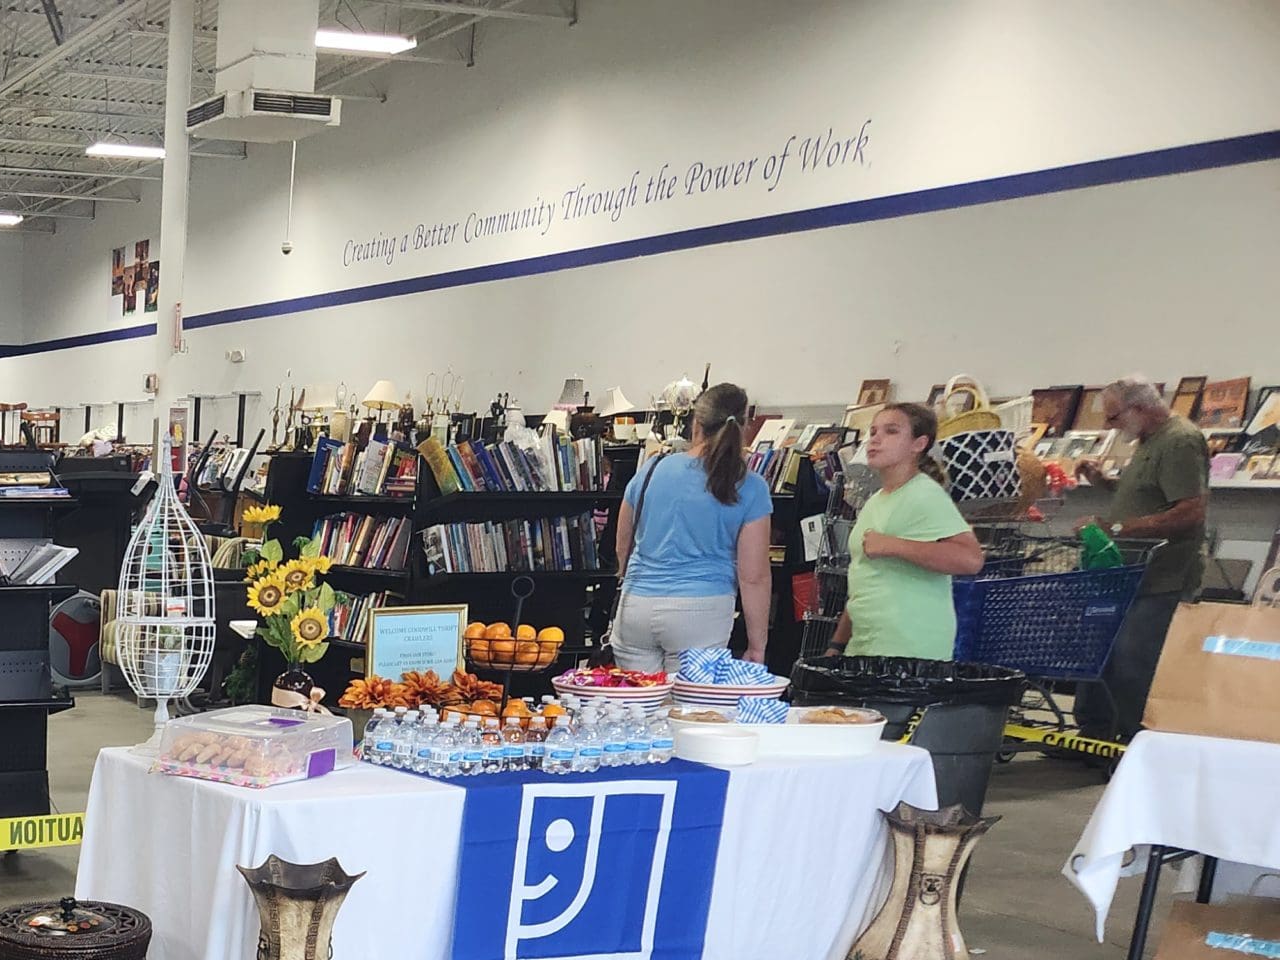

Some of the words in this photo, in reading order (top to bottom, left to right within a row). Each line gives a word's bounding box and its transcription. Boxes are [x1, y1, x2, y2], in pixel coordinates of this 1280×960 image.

[343, 231, 397, 267] Creating
[400, 234, 409, 253] a
[413, 222, 460, 250] Better
[464, 197, 556, 244] Community
[562, 170, 640, 223] Through
[645, 163, 677, 204] the
[685, 157, 759, 196] Power
[763, 135, 797, 192] of
